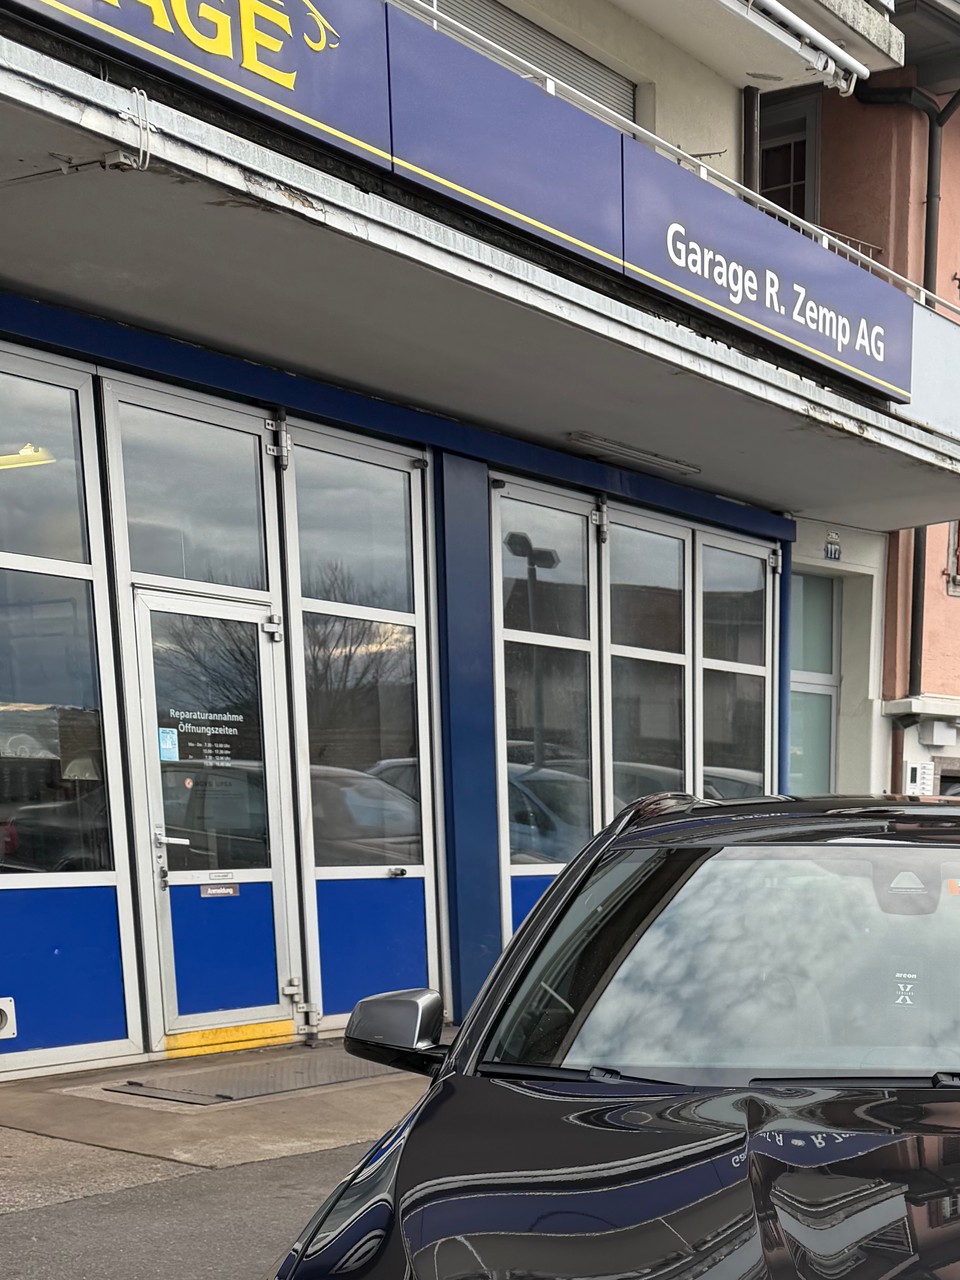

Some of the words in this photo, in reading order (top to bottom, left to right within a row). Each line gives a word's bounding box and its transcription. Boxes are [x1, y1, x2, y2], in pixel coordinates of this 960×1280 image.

[105, 0, 297, 90] GE
[666, 222, 758, 304] Garage
[765, 269, 786, 315] R.
[792, 283, 850, 352] Zemp
[855, 318, 885, 362] AG
[169, 708, 244, 722] Reparaturannahme
[178, 721, 239, 736] Öffnungszeiten
